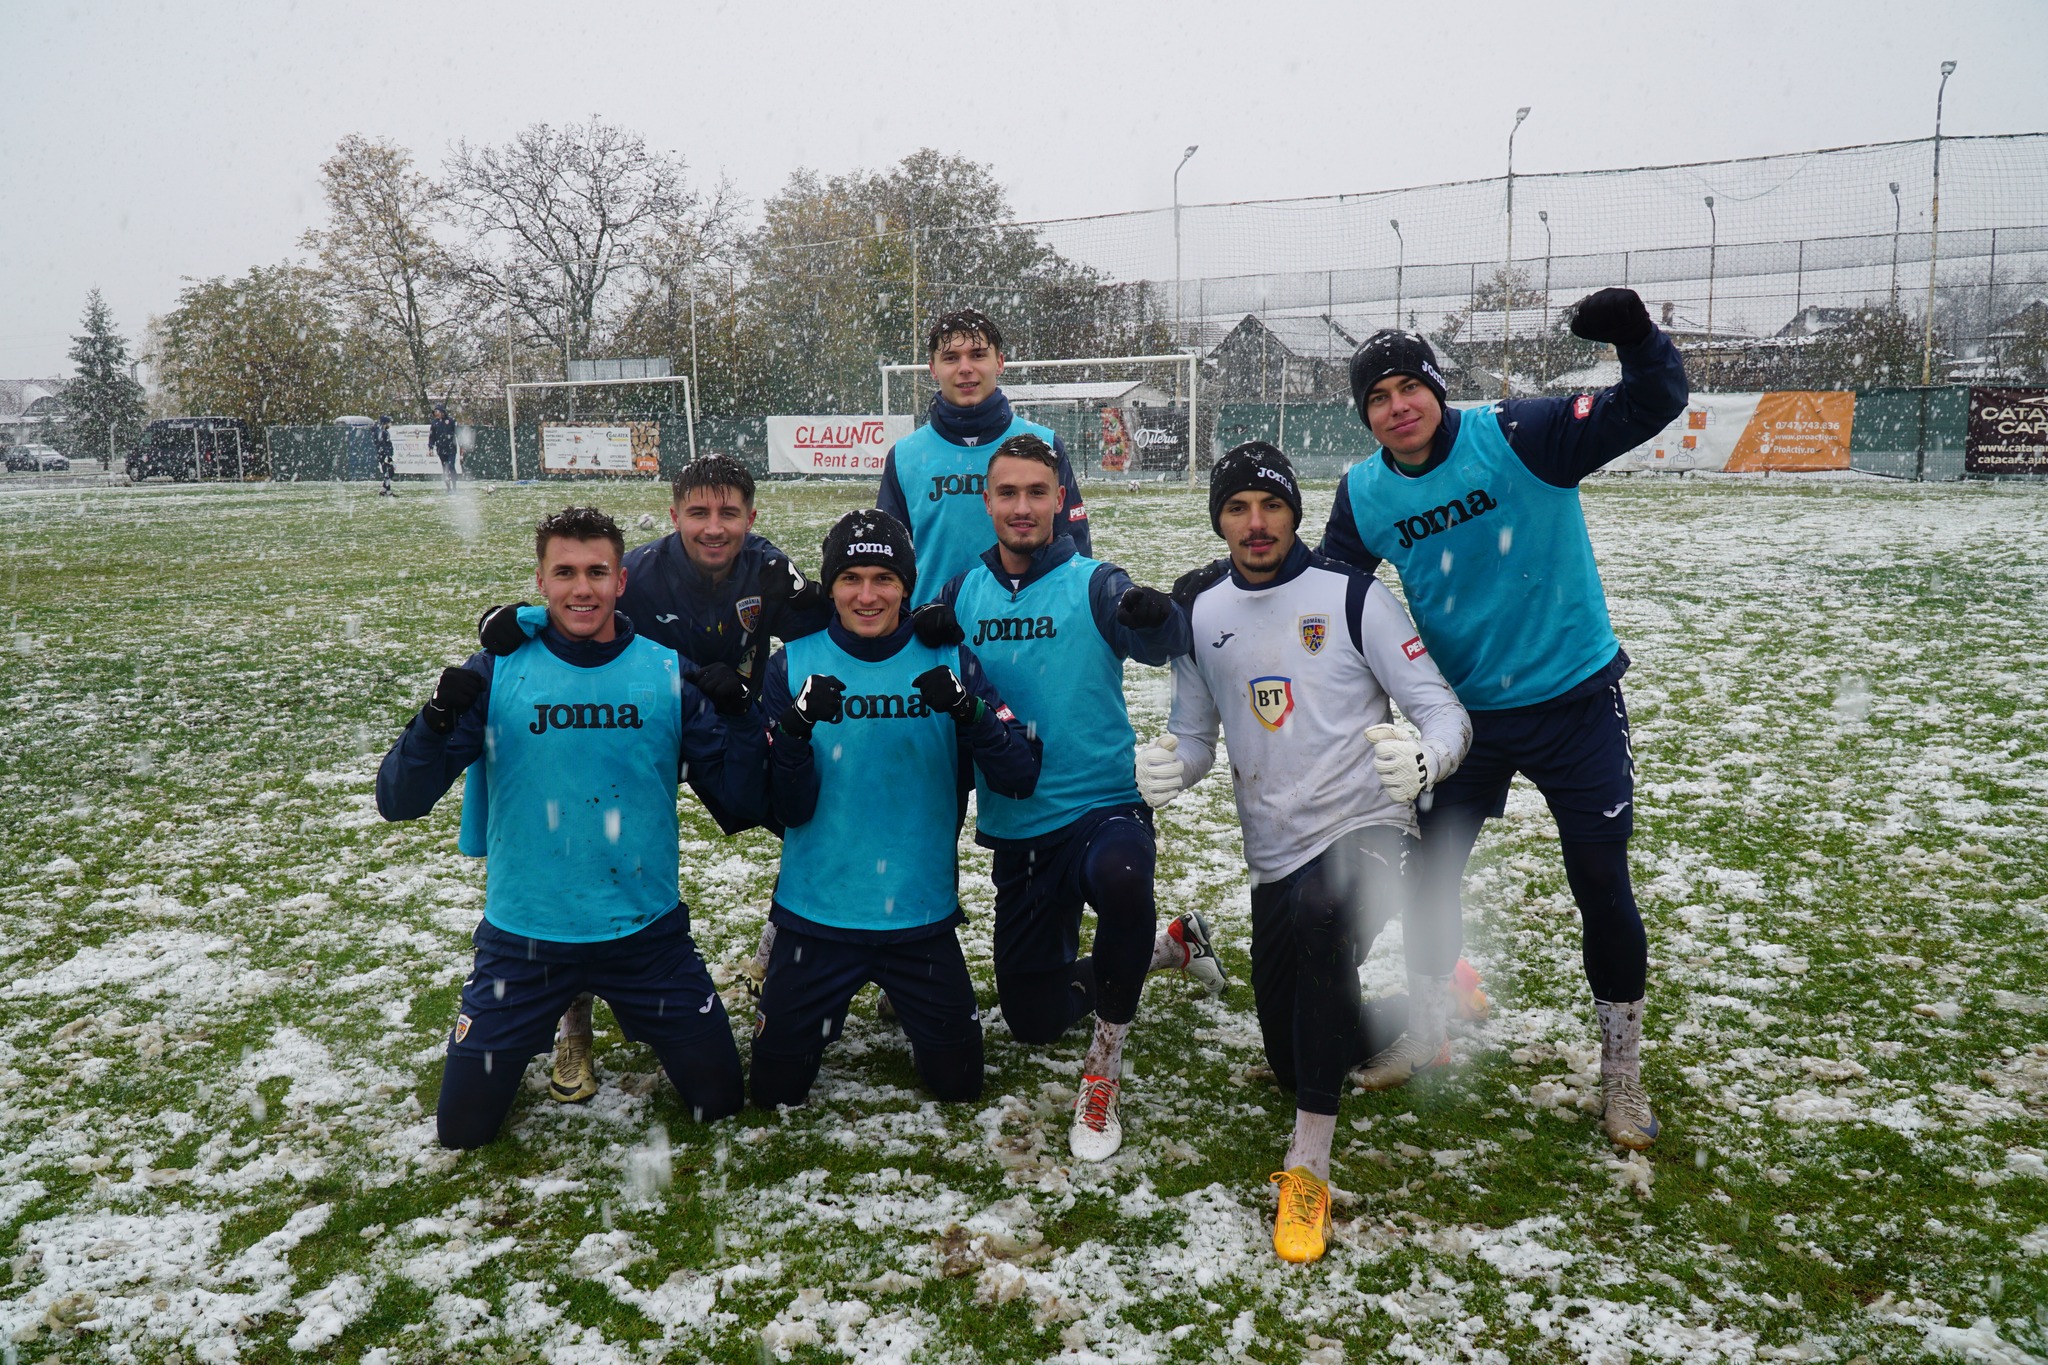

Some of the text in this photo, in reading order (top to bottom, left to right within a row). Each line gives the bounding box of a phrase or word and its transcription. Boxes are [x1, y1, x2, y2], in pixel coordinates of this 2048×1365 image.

[1134, 428, 1178, 448] Osteria
[813, 452, 884, 469] Rent a car
[929, 473, 988, 502] Jom
[1393, 489, 1498, 549] Joma
[847, 542, 893, 556] Joma
[973, 616, 1057, 647] Joma
[1257, 689, 1283, 707] BT
[529, 703, 643, 735] Joma
